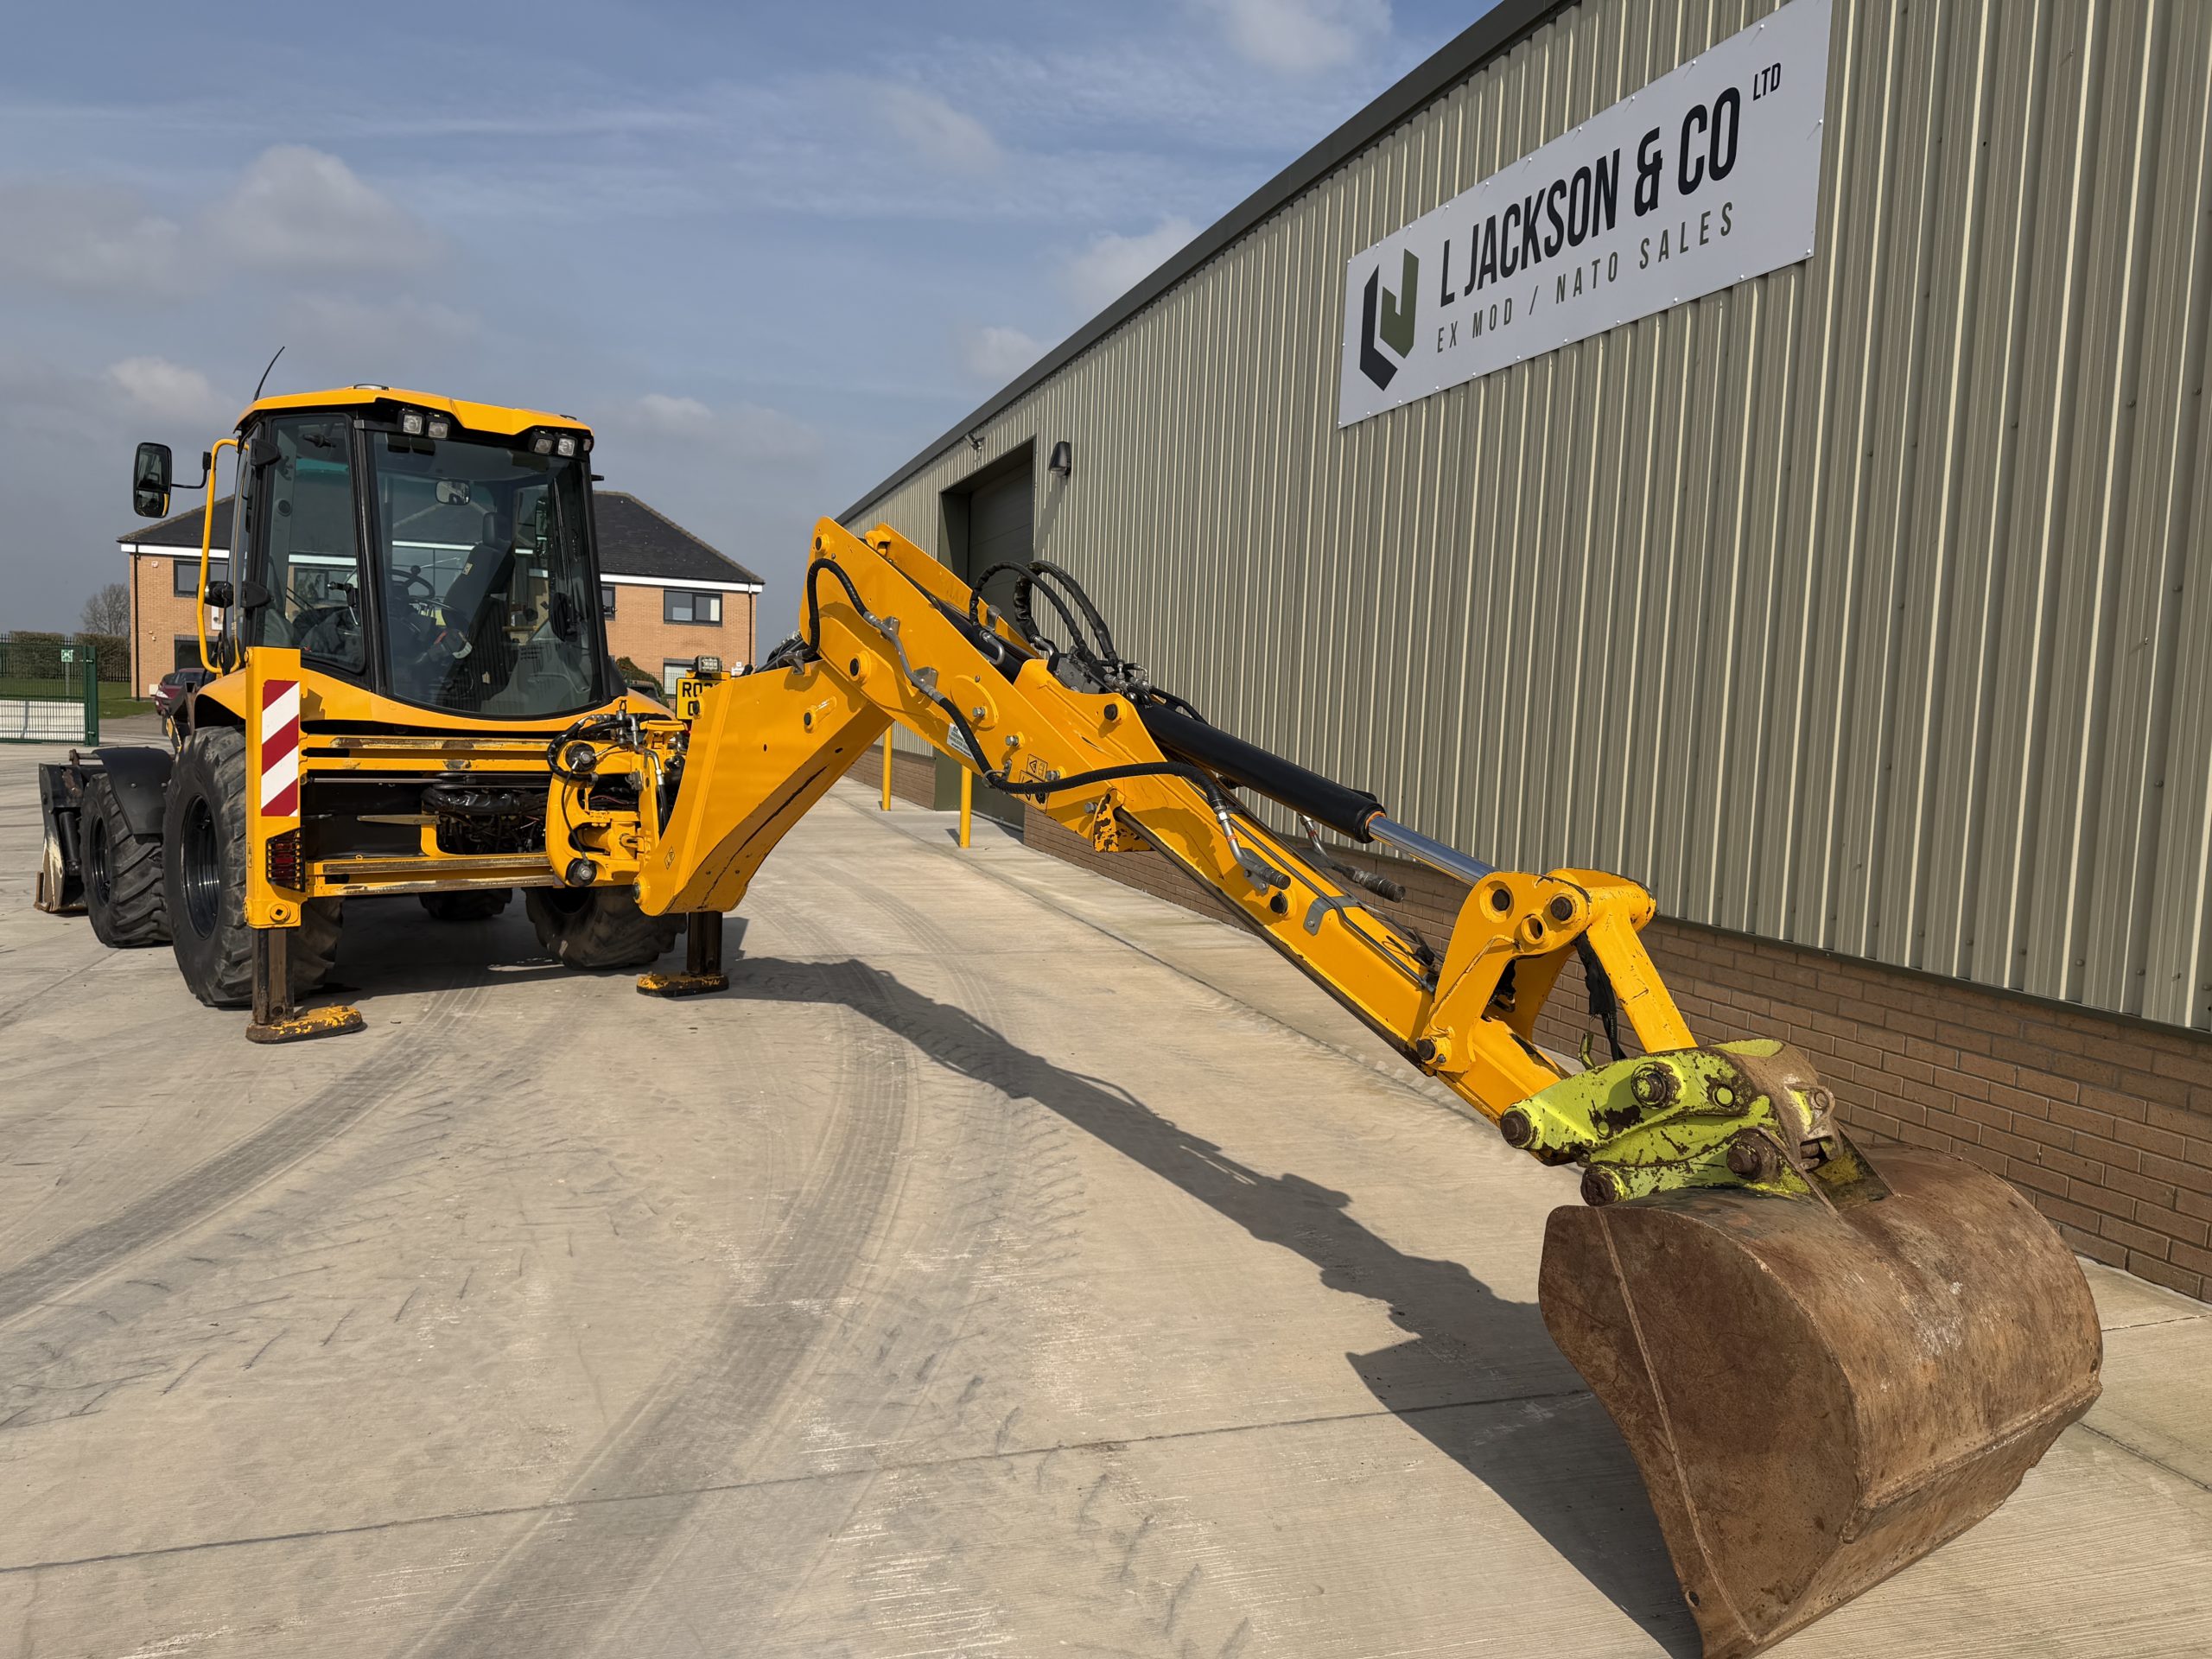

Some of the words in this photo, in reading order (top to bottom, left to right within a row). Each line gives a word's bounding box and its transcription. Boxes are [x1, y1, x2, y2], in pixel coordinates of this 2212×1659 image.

[1437, 321, 1458, 353] EX
[1472, 297, 1512, 339] MOD
[1555, 251, 1618, 304] NATO
[1639, 201, 1732, 270] SALES
[1440, 239, 1455, 308] L
[1464, 148, 1620, 296] JACKSON
[1634, 126, 1662, 217] &
[1678, 86, 1740, 195] CO
[1752, 62, 1782, 101] LTD
